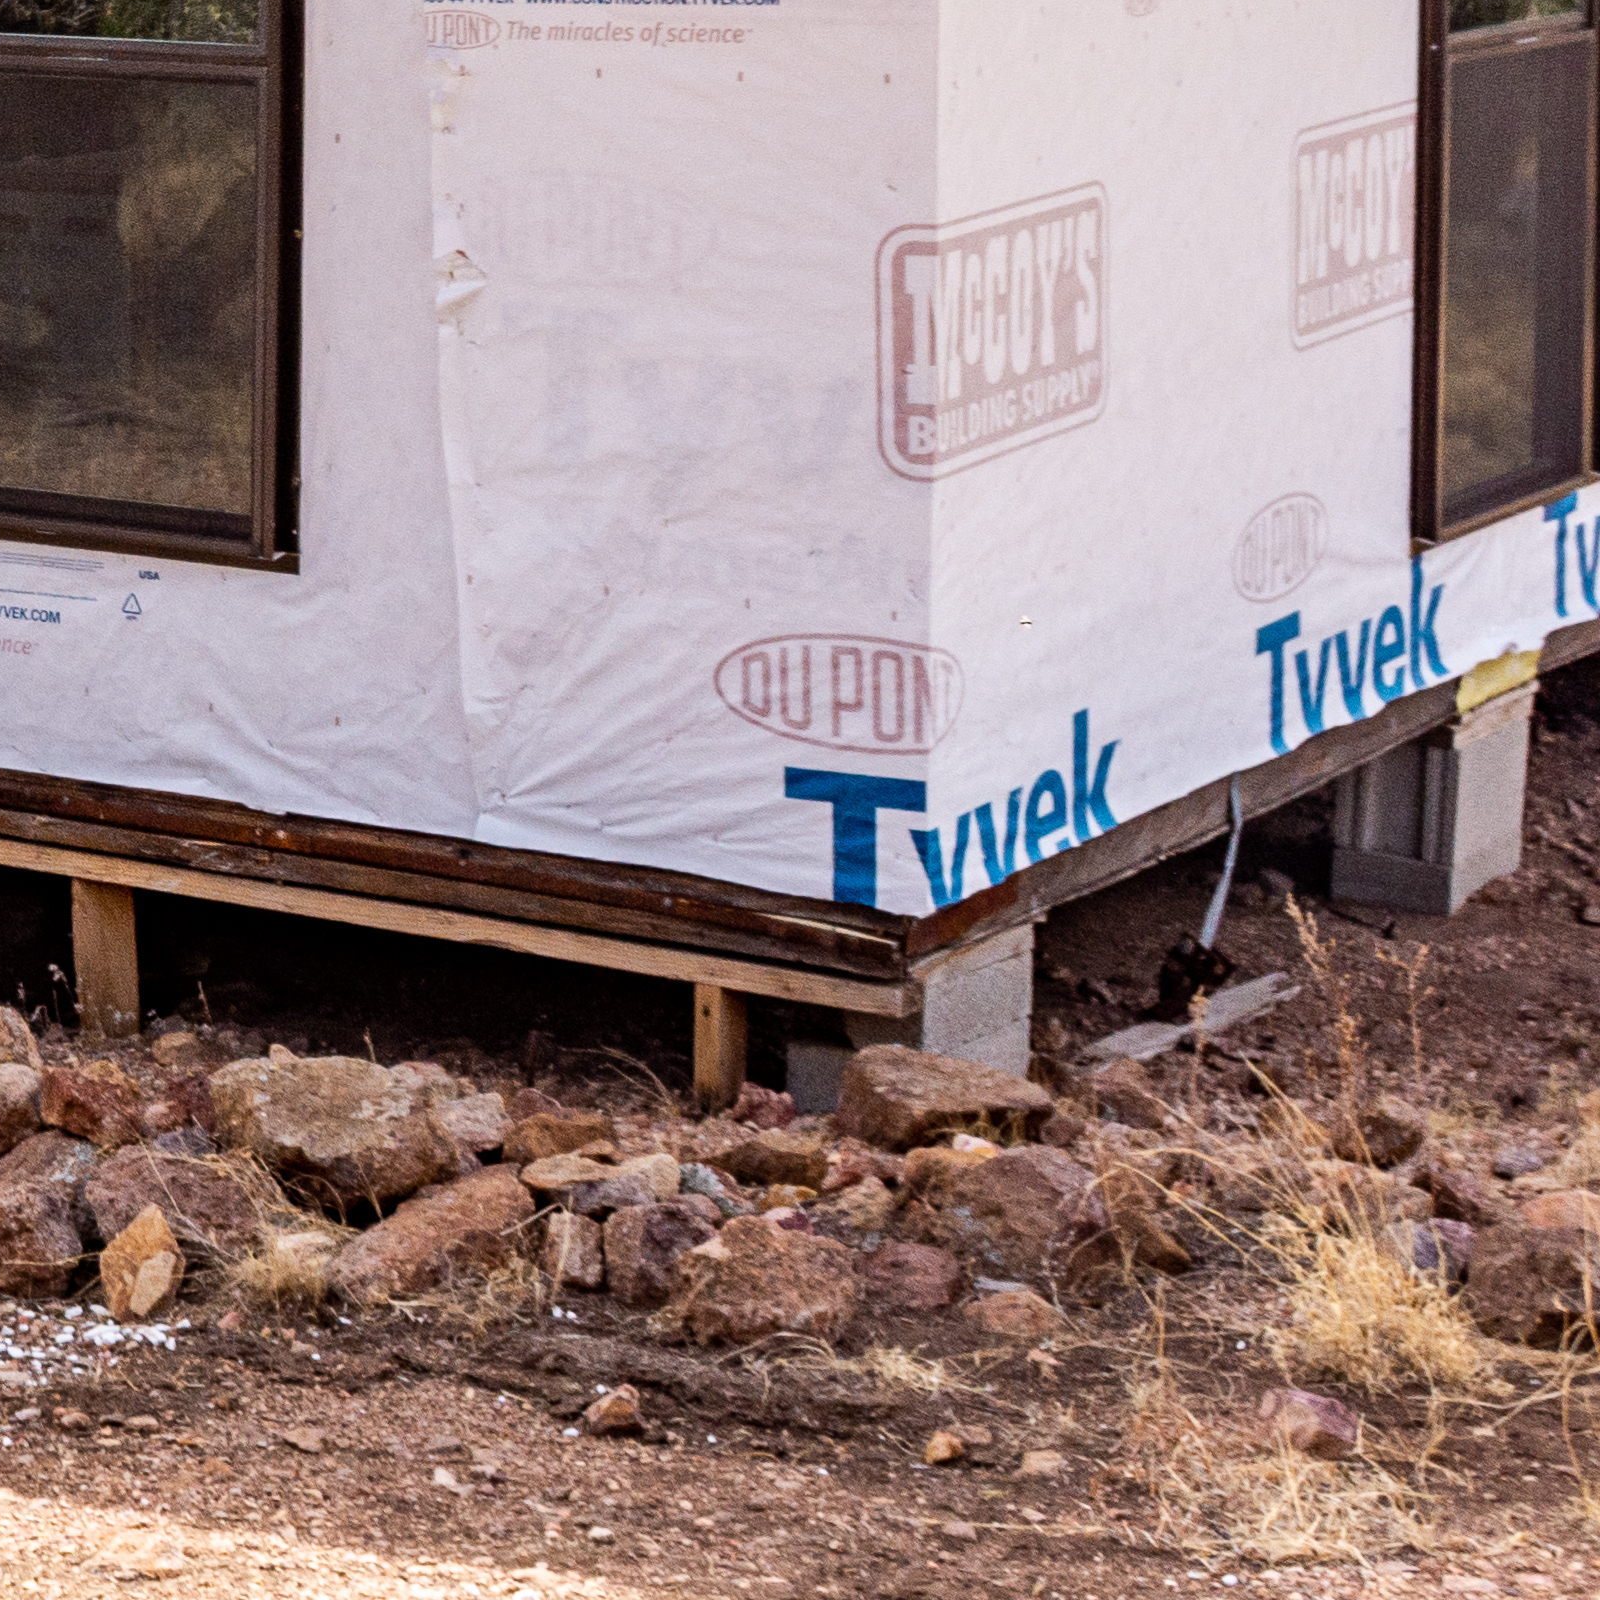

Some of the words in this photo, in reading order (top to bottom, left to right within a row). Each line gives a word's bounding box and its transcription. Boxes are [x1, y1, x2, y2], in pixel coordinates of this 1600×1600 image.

[506, 20, 542, 41] The
[548, 20, 634, 42] miracles
[639, 21, 664, 48] of
[665, 22, 745, 44] science
[138, 569, 161, 581] USA
